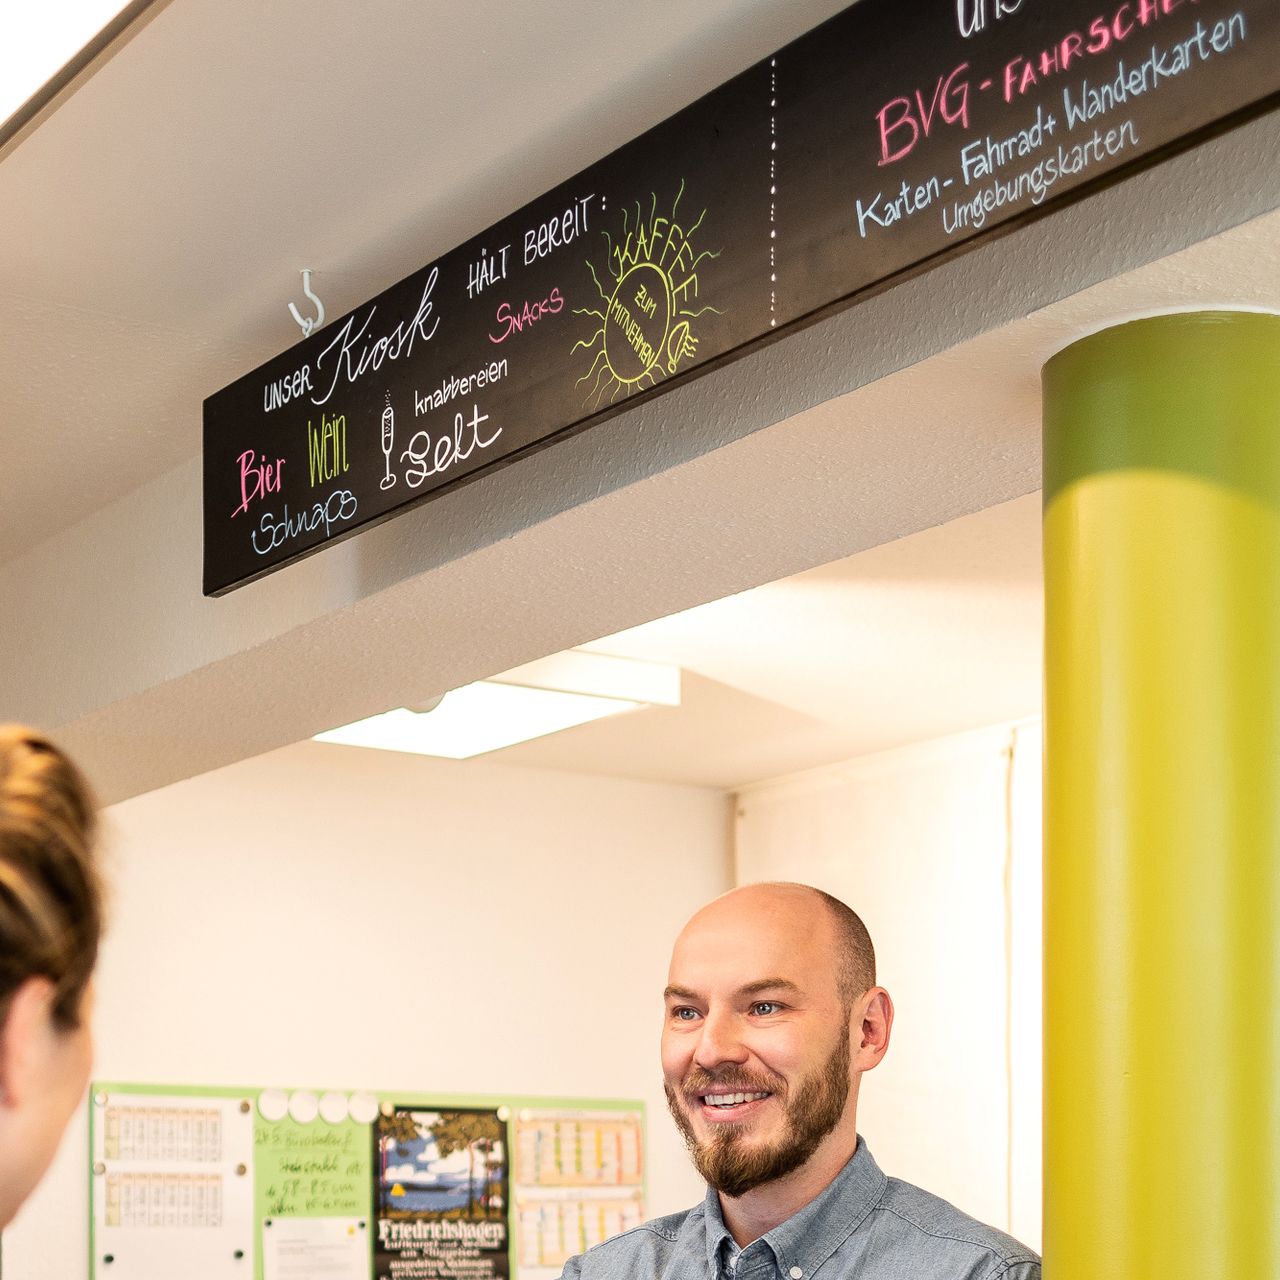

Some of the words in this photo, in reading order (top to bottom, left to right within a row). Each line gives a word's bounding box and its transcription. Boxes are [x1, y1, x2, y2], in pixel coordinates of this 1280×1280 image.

[1063, 10, 1246, 131] Wanderkarten
[875, 62, 970, 167] BVG
[942, 119, 1139, 234] Umgebungskarten
[613, 217, 699, 318] KAFFEE
[634, 283, 658, 320] ZUM
[310, 265, 441, 405] Kiosk
[466, 247, 512, 299] HÄLT
[610, 297, 656, 368] MITNEHMEN
[414, 359, 508, 418] knabbereien
[230, 448, 286, 519] Bier
[307, 412, 350, 488] Wein
[399, 403, 503, 489] Sekt
[251, 489, 358, 555] Schnaps
[378, 1218, 505, 1243] Friedrichshagen
